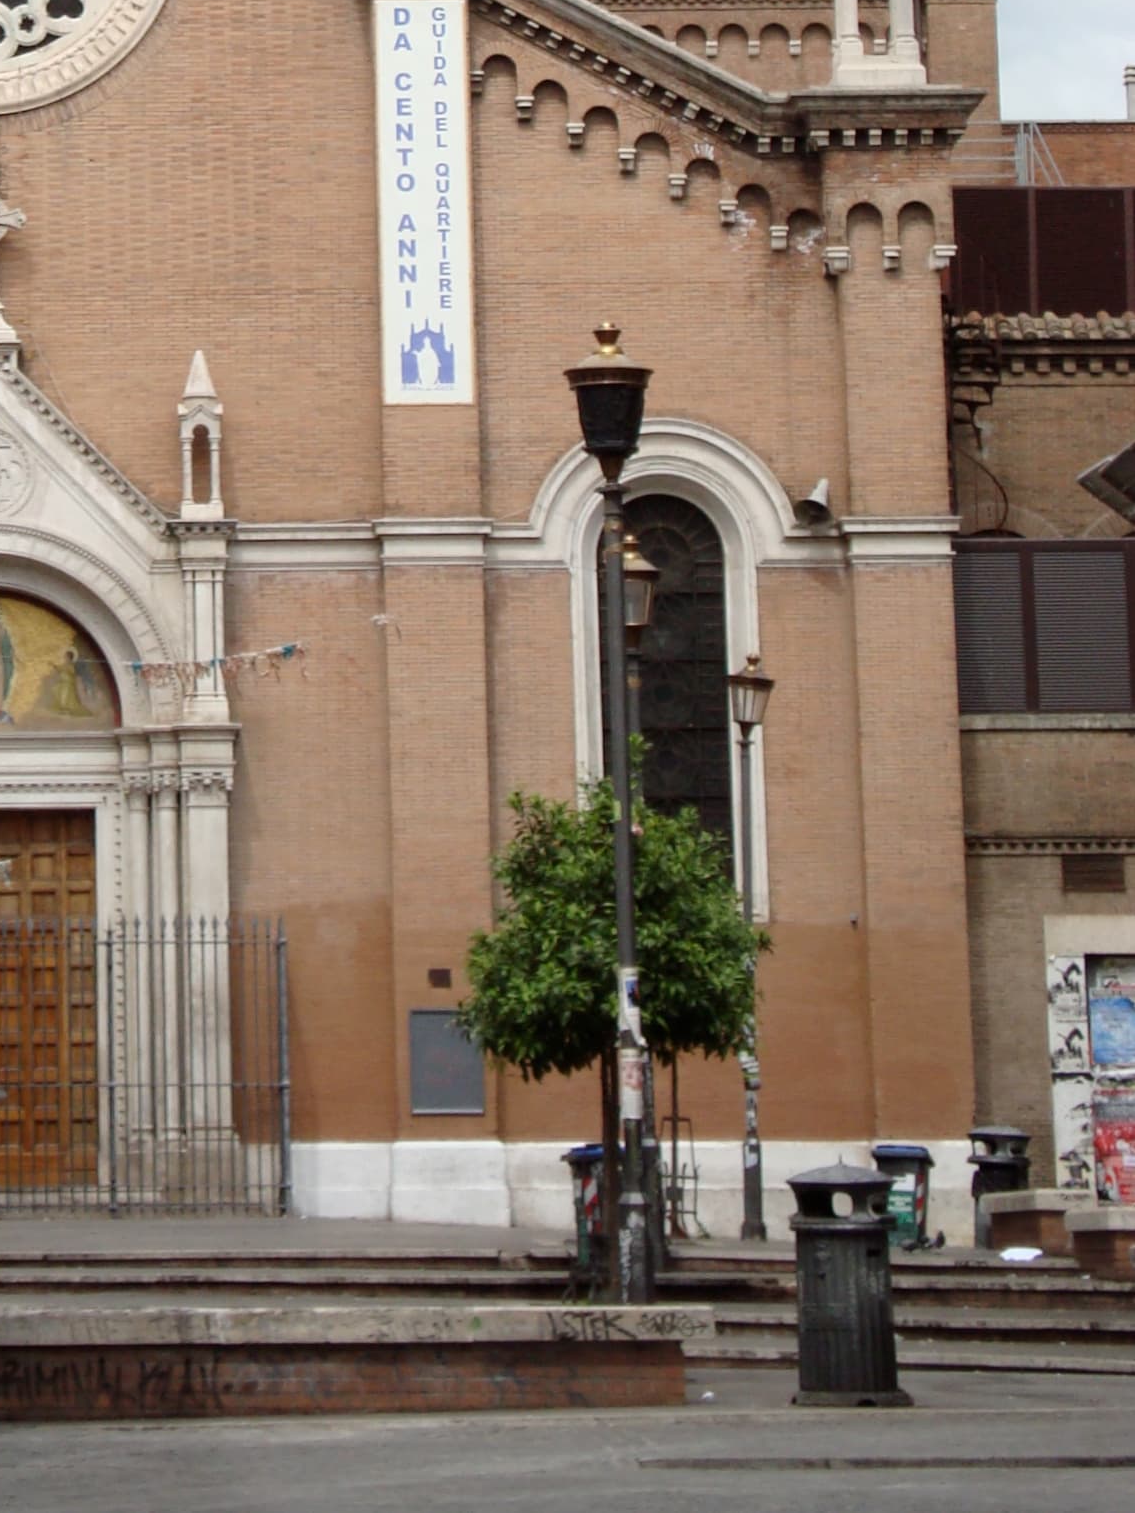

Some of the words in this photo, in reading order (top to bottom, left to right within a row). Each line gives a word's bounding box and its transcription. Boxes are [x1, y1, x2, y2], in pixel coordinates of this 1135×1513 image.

[394, 7, 412, 50] DA
[432, 7, 447, 85] GUIDA
[394, 73, 415, 192] CENTO
[435, 102, 448, 148] DEL
[398, 214, 417, 308] ANNI
[436, 163, 452, 309] QUARTIERE
